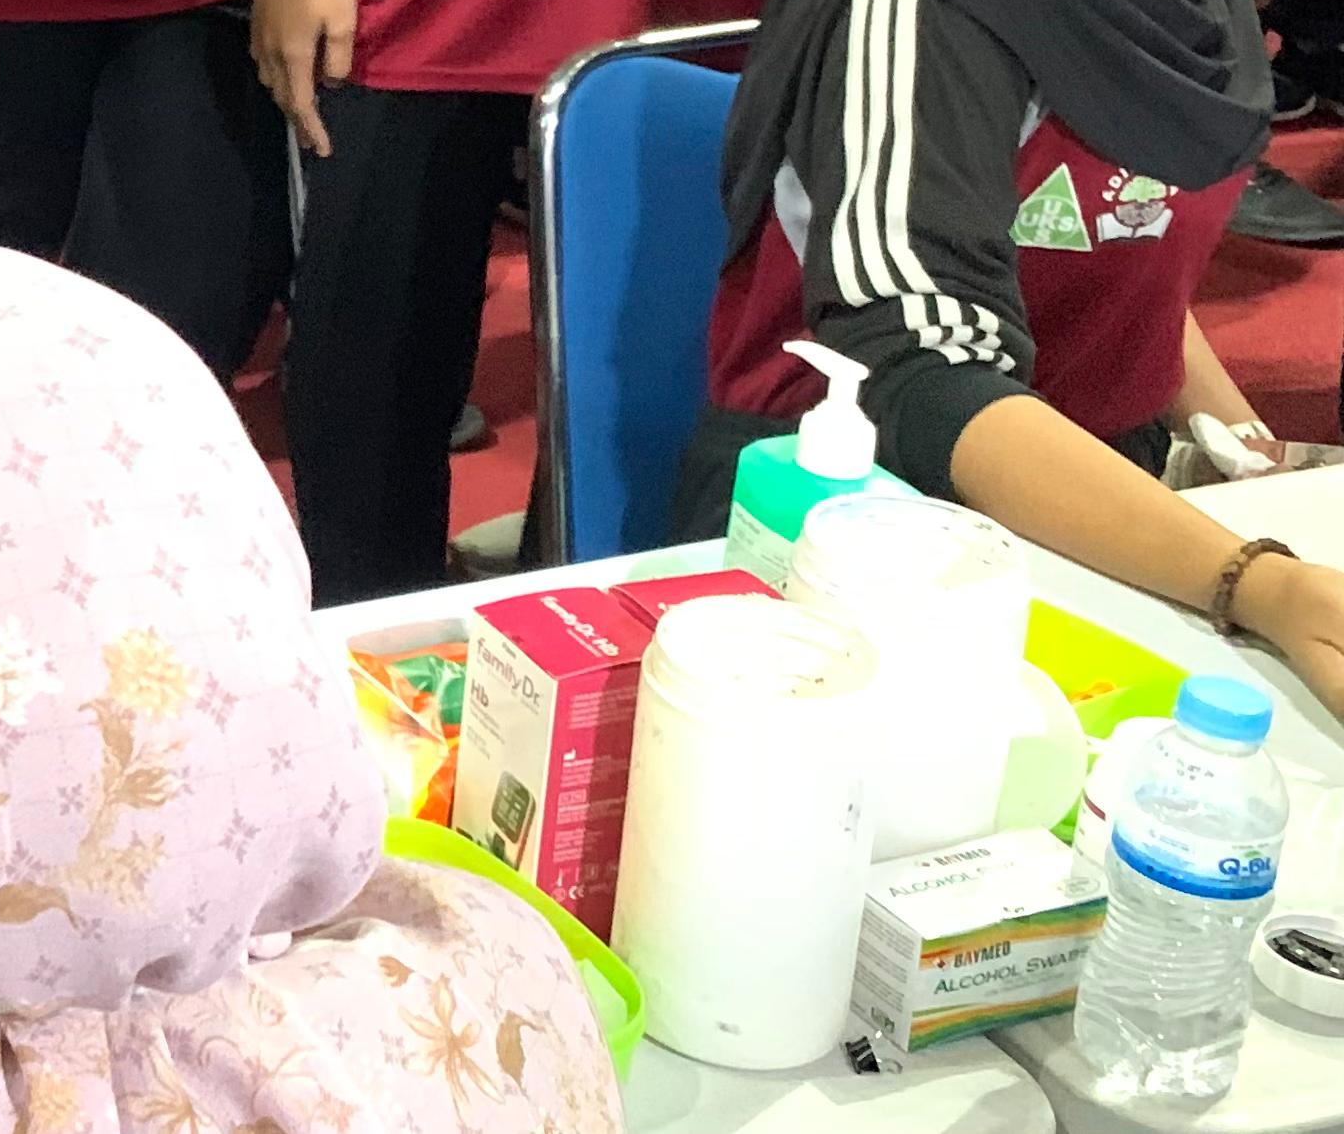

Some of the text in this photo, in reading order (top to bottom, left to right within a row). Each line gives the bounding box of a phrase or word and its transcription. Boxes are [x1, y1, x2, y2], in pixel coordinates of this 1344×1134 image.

[470, 678, 490, 708] Hb
[934, 848, 992, 866] BAYMED
[954, 940, 1012, 968] BAYMED
[934, 965, 1021, 995] ALCOHOL
